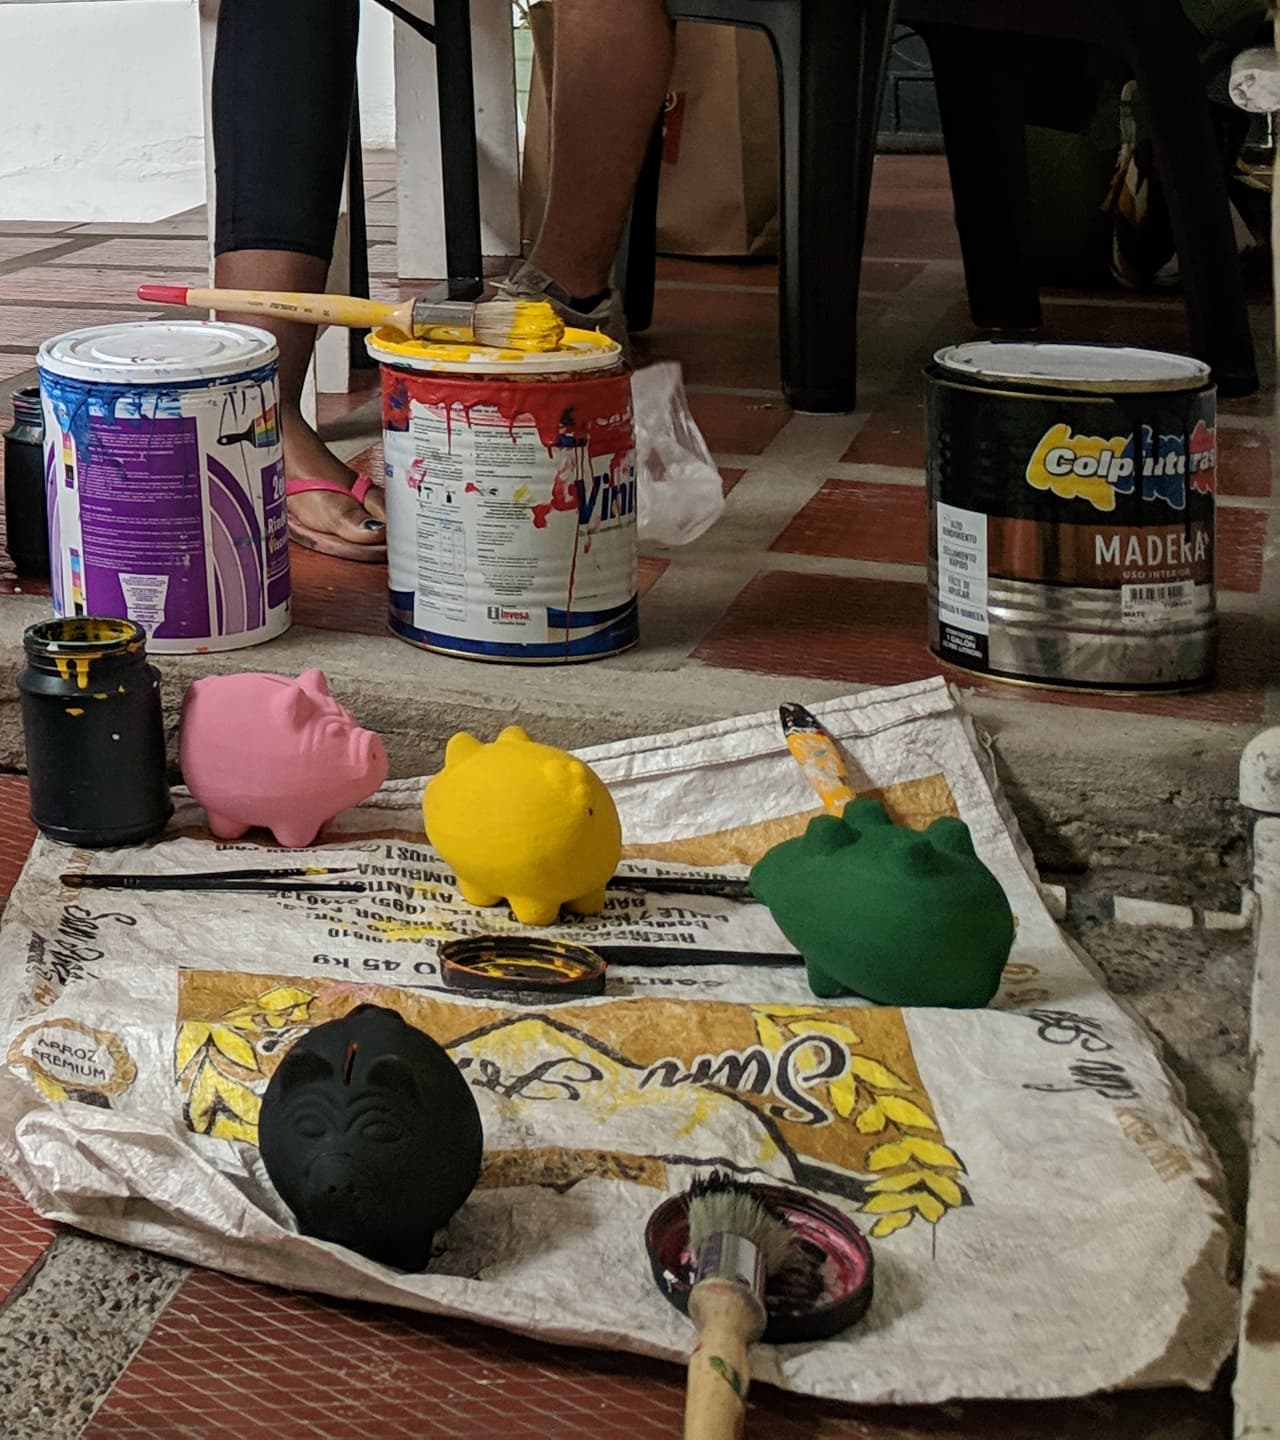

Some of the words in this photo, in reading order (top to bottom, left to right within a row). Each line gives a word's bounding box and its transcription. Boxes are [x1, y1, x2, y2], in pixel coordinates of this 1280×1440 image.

[1045, 448, 1216, 483] Colpnturas
[1123, 571, 1145, 579] USO
[357, 863, 457, 887] OMBIANA
[312, 954, 349, 969] kg
[362, 958, 400, 972] 45
[38, 1039, 97, 1063] ARROZ
[31, 1048, 107, 1080] PREMIUM
